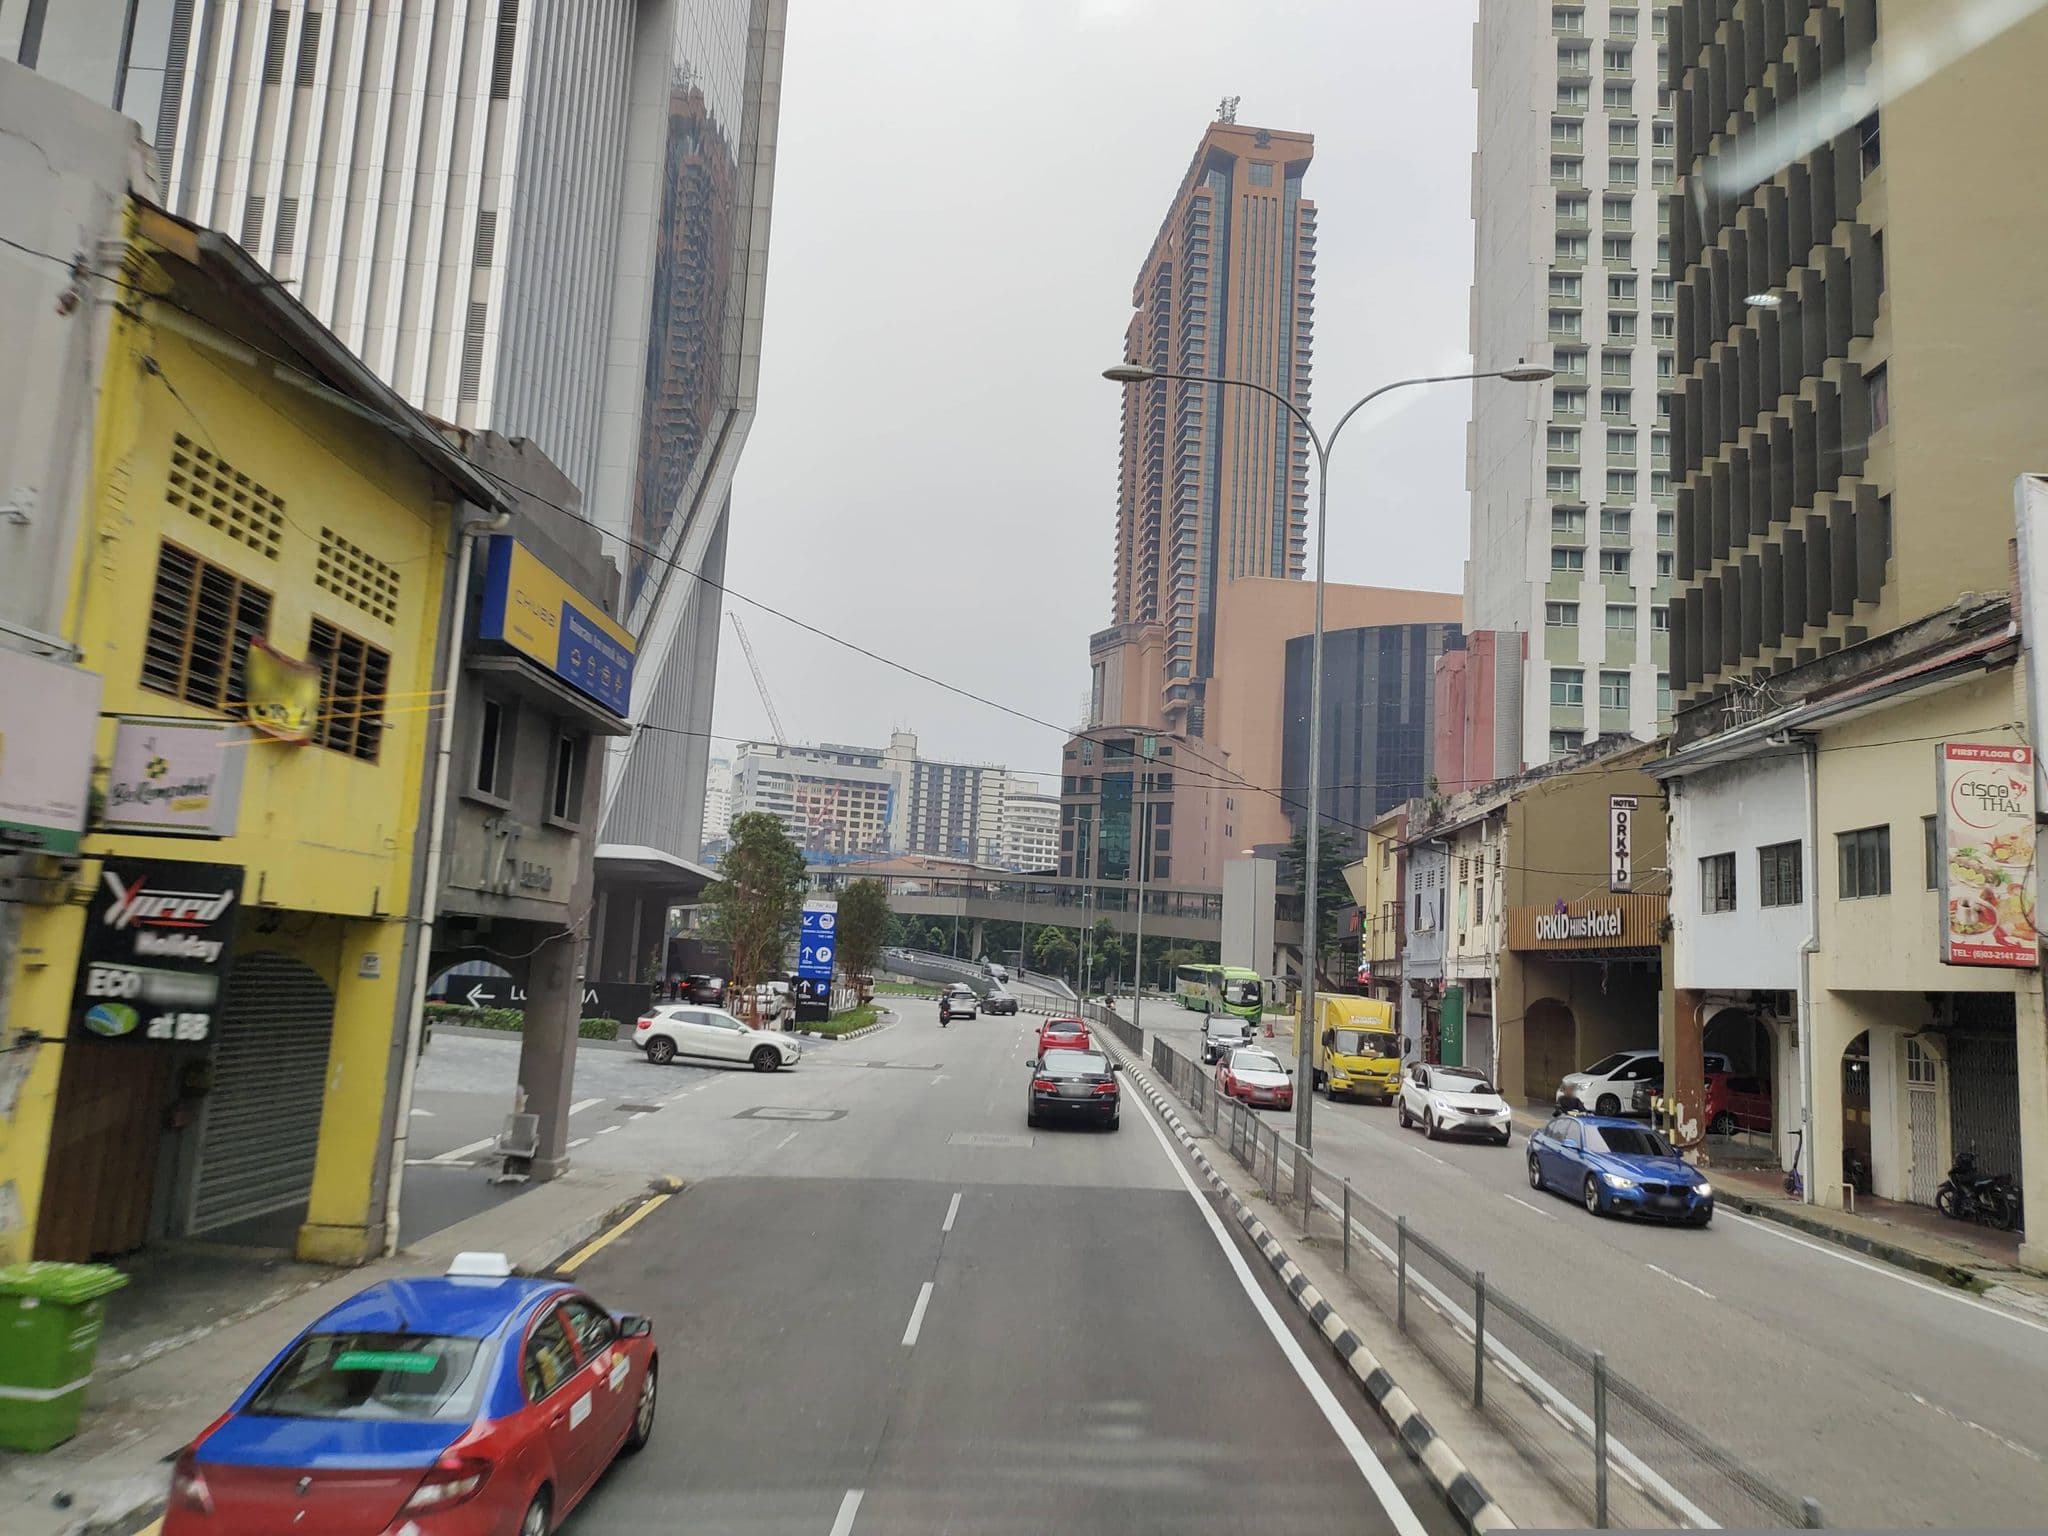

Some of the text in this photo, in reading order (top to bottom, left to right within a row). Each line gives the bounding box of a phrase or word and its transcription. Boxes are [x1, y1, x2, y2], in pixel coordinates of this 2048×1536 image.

[1951, 748, 2011, 758] FIRST FLOOR
[1613, 799, 1636, 807] HOTEL
[1616, 812, 1629, 882] ORKID
[1536, 910, 1569, 940] ORKID
[1588, 907, 1621, 937] Hotel
[86, 968, 142, 999] ECO
